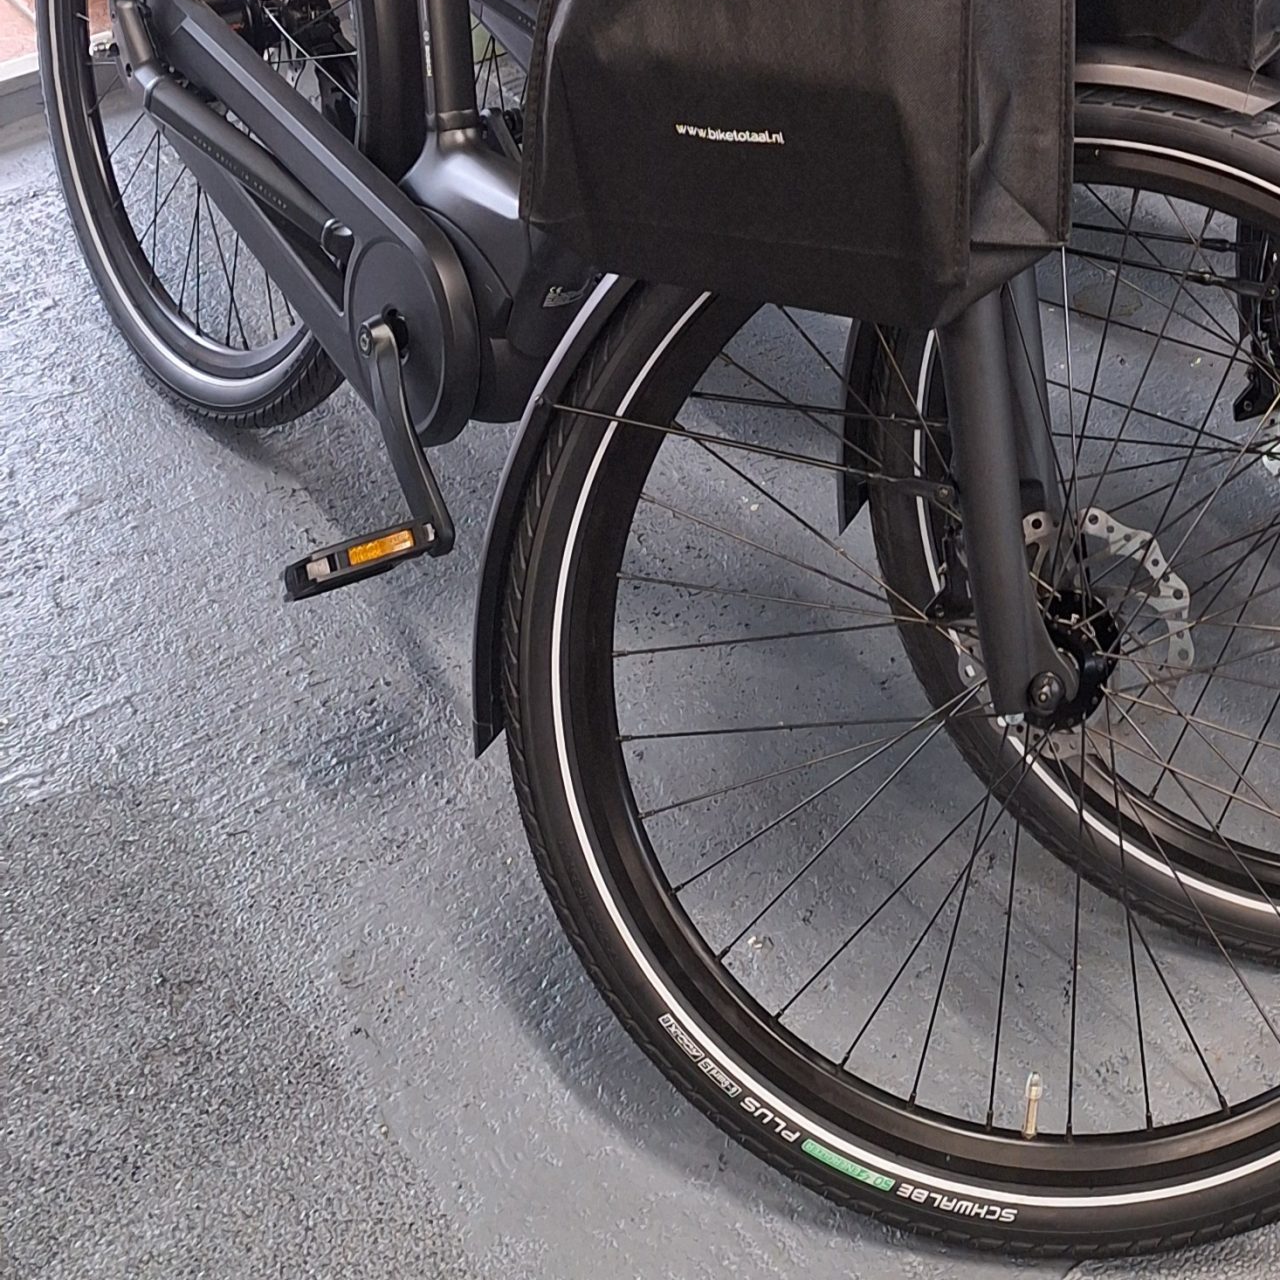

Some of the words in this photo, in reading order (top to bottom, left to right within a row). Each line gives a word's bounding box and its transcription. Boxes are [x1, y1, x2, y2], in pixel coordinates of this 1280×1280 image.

[675, 123, 785, 145] www.biketotaal.nl
[739, 1096, 801, 1143] PLUS
[896, 1182, 1019, 1223] SCHWALBE
